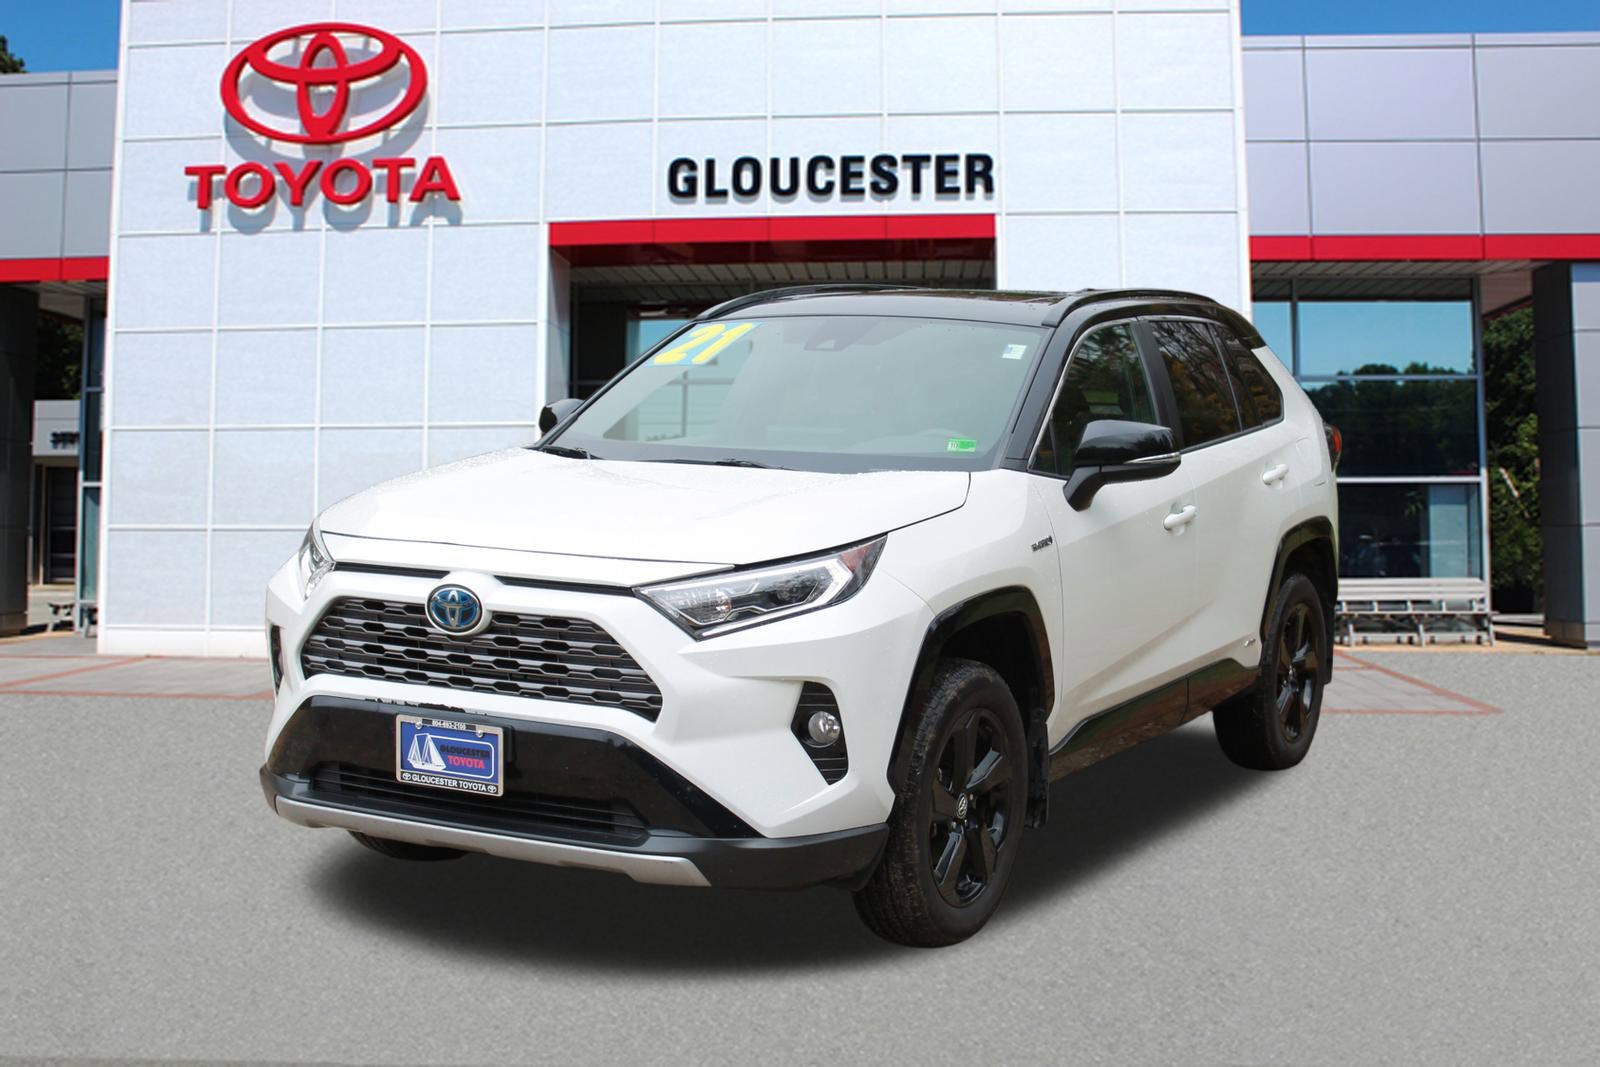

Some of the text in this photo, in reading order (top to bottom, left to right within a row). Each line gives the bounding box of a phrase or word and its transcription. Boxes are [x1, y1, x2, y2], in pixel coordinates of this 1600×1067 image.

[185, 156, 461, 210] TOYOTA
[668, 154, 994, 198] GLOUCESTER
[654, 323, 754, 365] 21
[440, 745, 490, 758] GLOUCESTER
[447, 755, 485, 769] TOYOTA
[411, 774, 487, 792] GLOUCESTER TOYOTA
